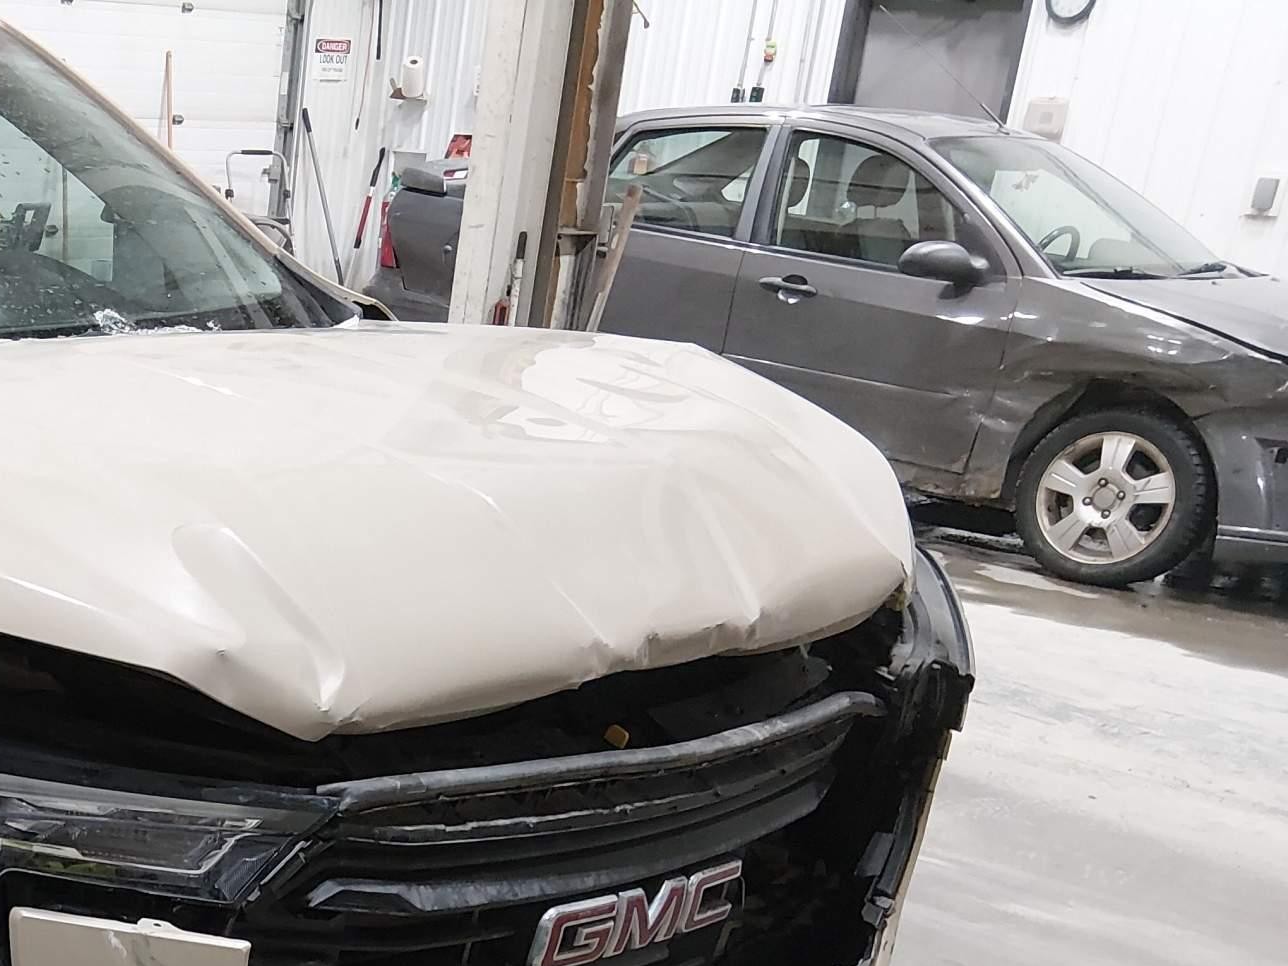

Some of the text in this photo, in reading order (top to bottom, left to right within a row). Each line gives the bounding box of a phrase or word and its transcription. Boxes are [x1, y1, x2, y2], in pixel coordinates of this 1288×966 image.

[321, 42, 347, 51] DANGER
[319, 54, 347, 64] LOOK OUT
